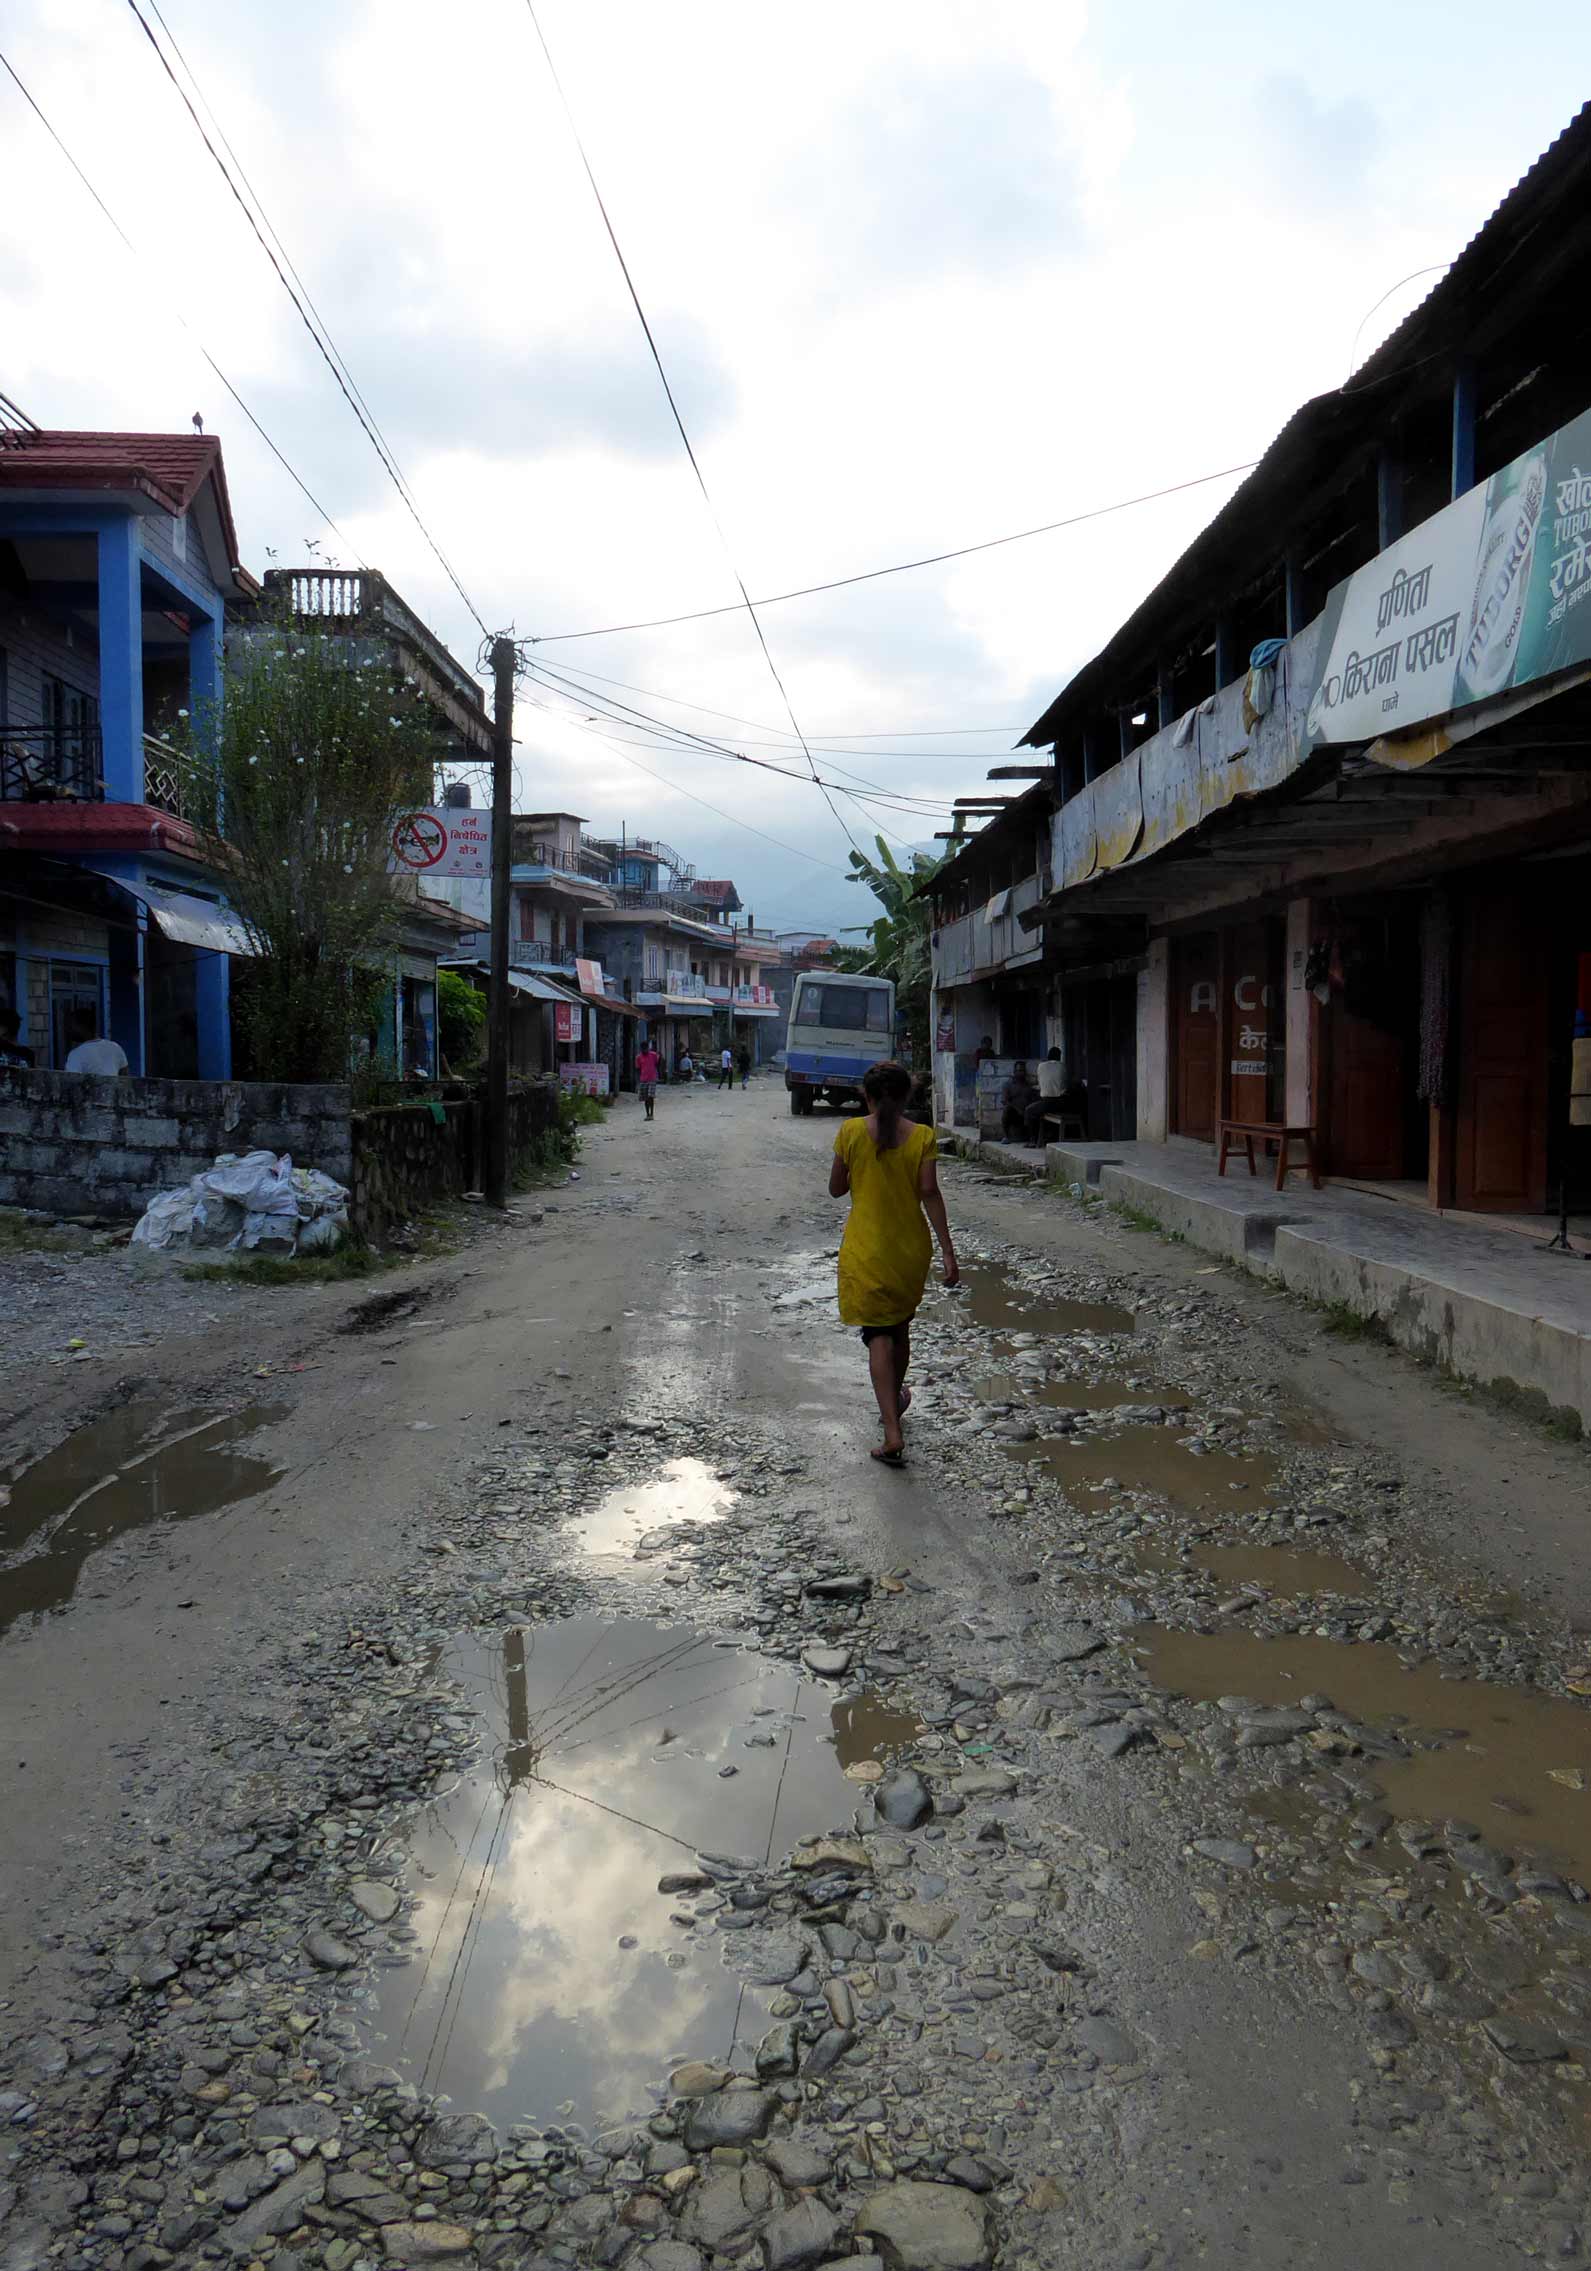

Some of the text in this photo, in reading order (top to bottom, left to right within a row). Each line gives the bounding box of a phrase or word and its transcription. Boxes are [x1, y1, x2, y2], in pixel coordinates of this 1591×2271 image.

[1553, 508, 1591, 548] TUBO
[1376, 563, 1433, 638] प्रणिता
[1465, 517, 1531, 672] TUBORG
[1550, 536, 1591, 598] रमे
[1340, 611, 1461, 700] किराना पसल
[1505, 606, 1522, 649] GOLD
